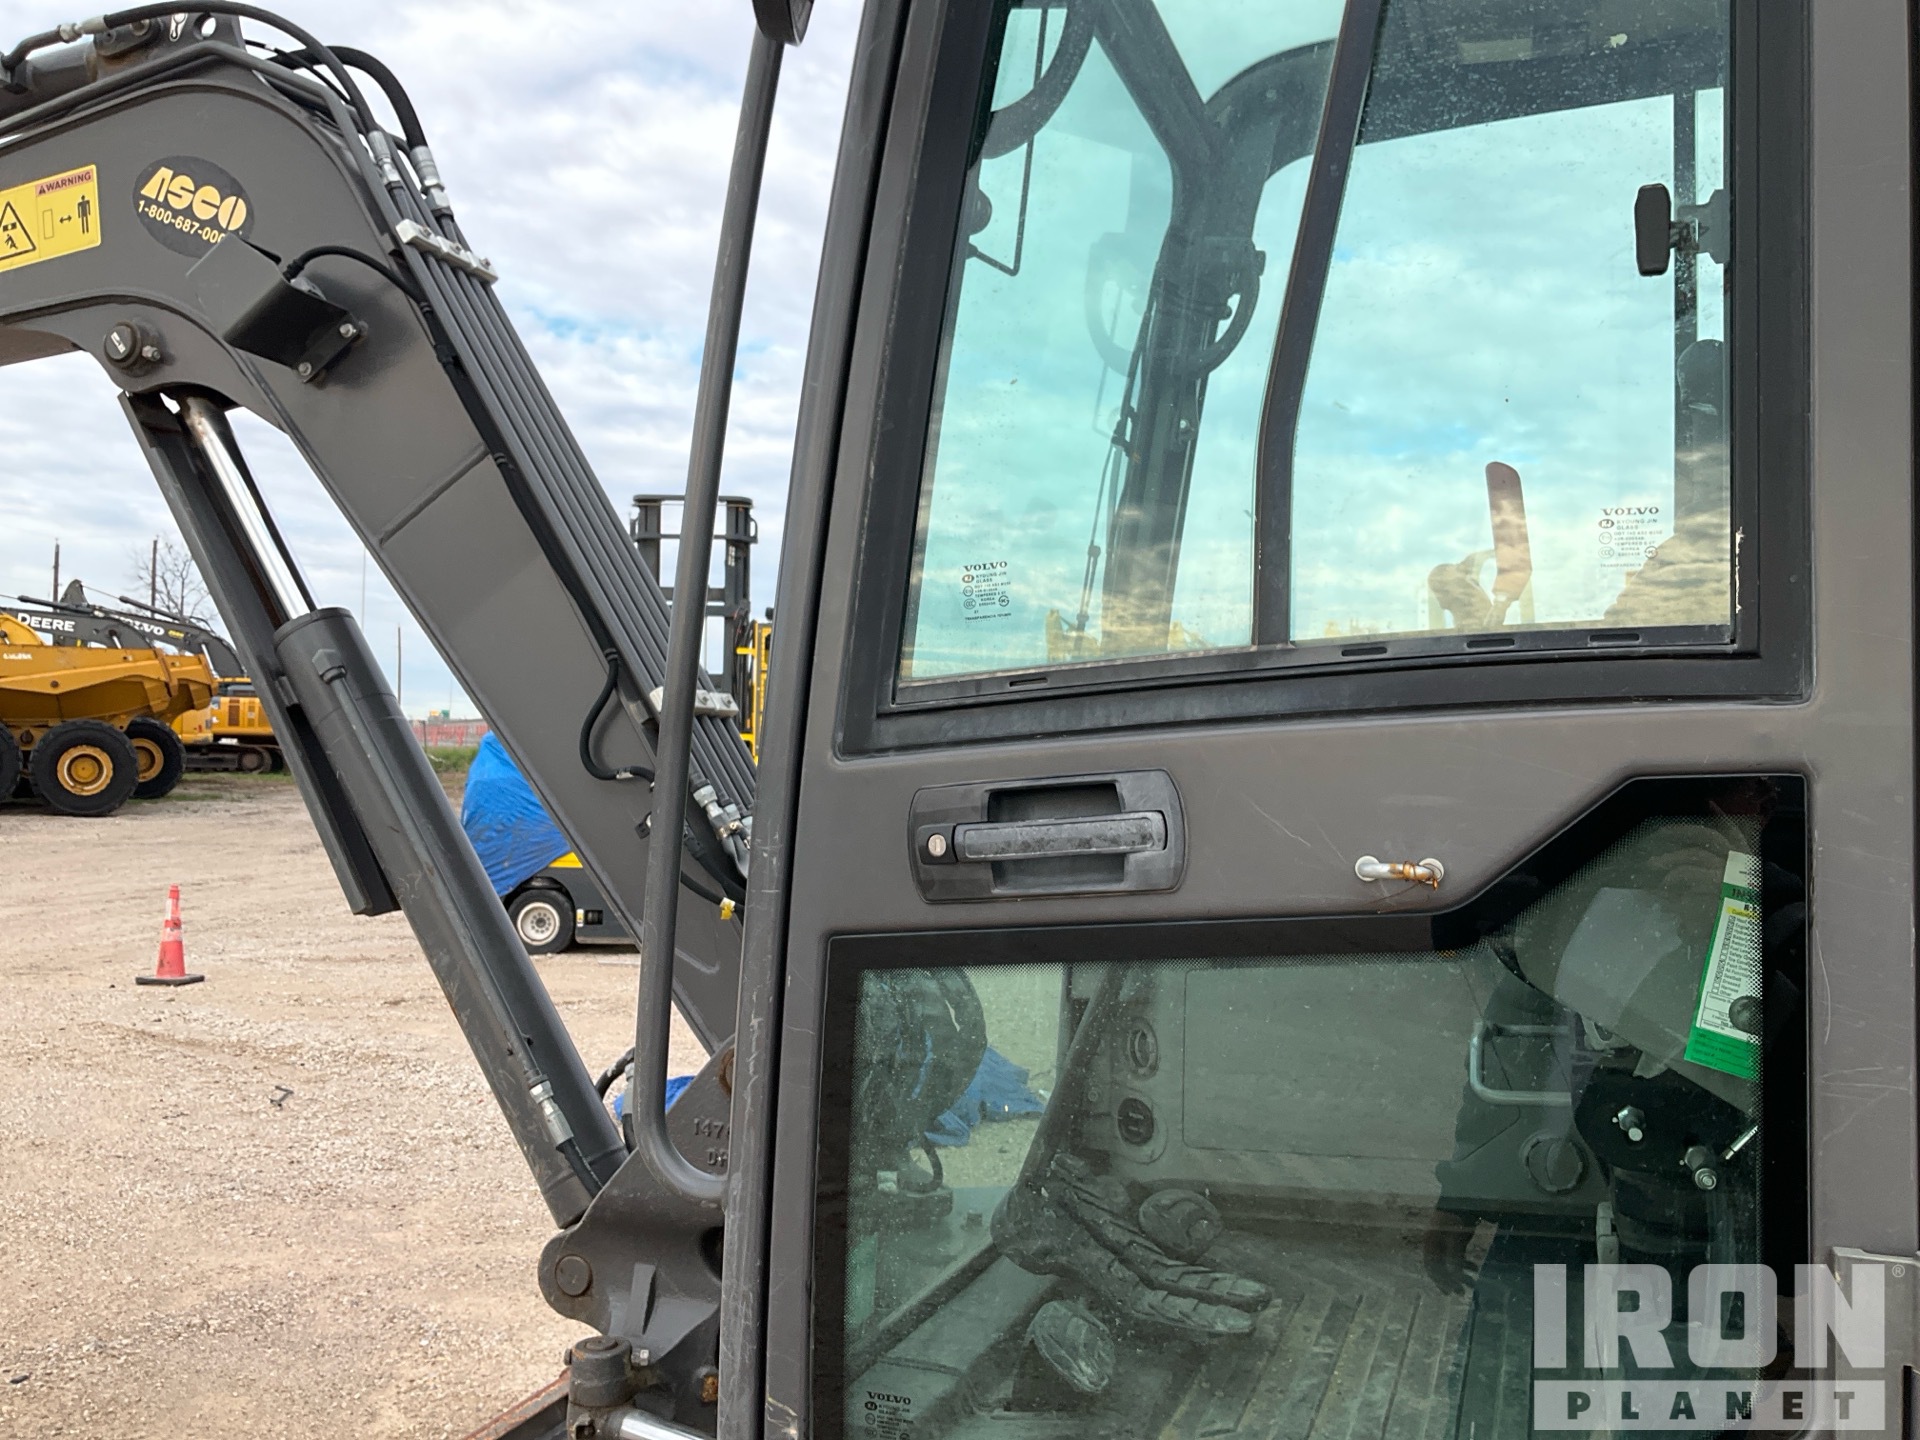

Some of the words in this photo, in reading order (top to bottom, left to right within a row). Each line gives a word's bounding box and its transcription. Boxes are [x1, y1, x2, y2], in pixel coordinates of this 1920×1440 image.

[44, 172, 91, 192] WARNING
[140, 166, 247, 231] ASCO
[1600, 506, 1659, 516] VOLVO
[963, 561, 1007, 572] VOLVO
[17, 612, 76, 633] DEERE
[866, 1391, 911, 1405] VOLVO
